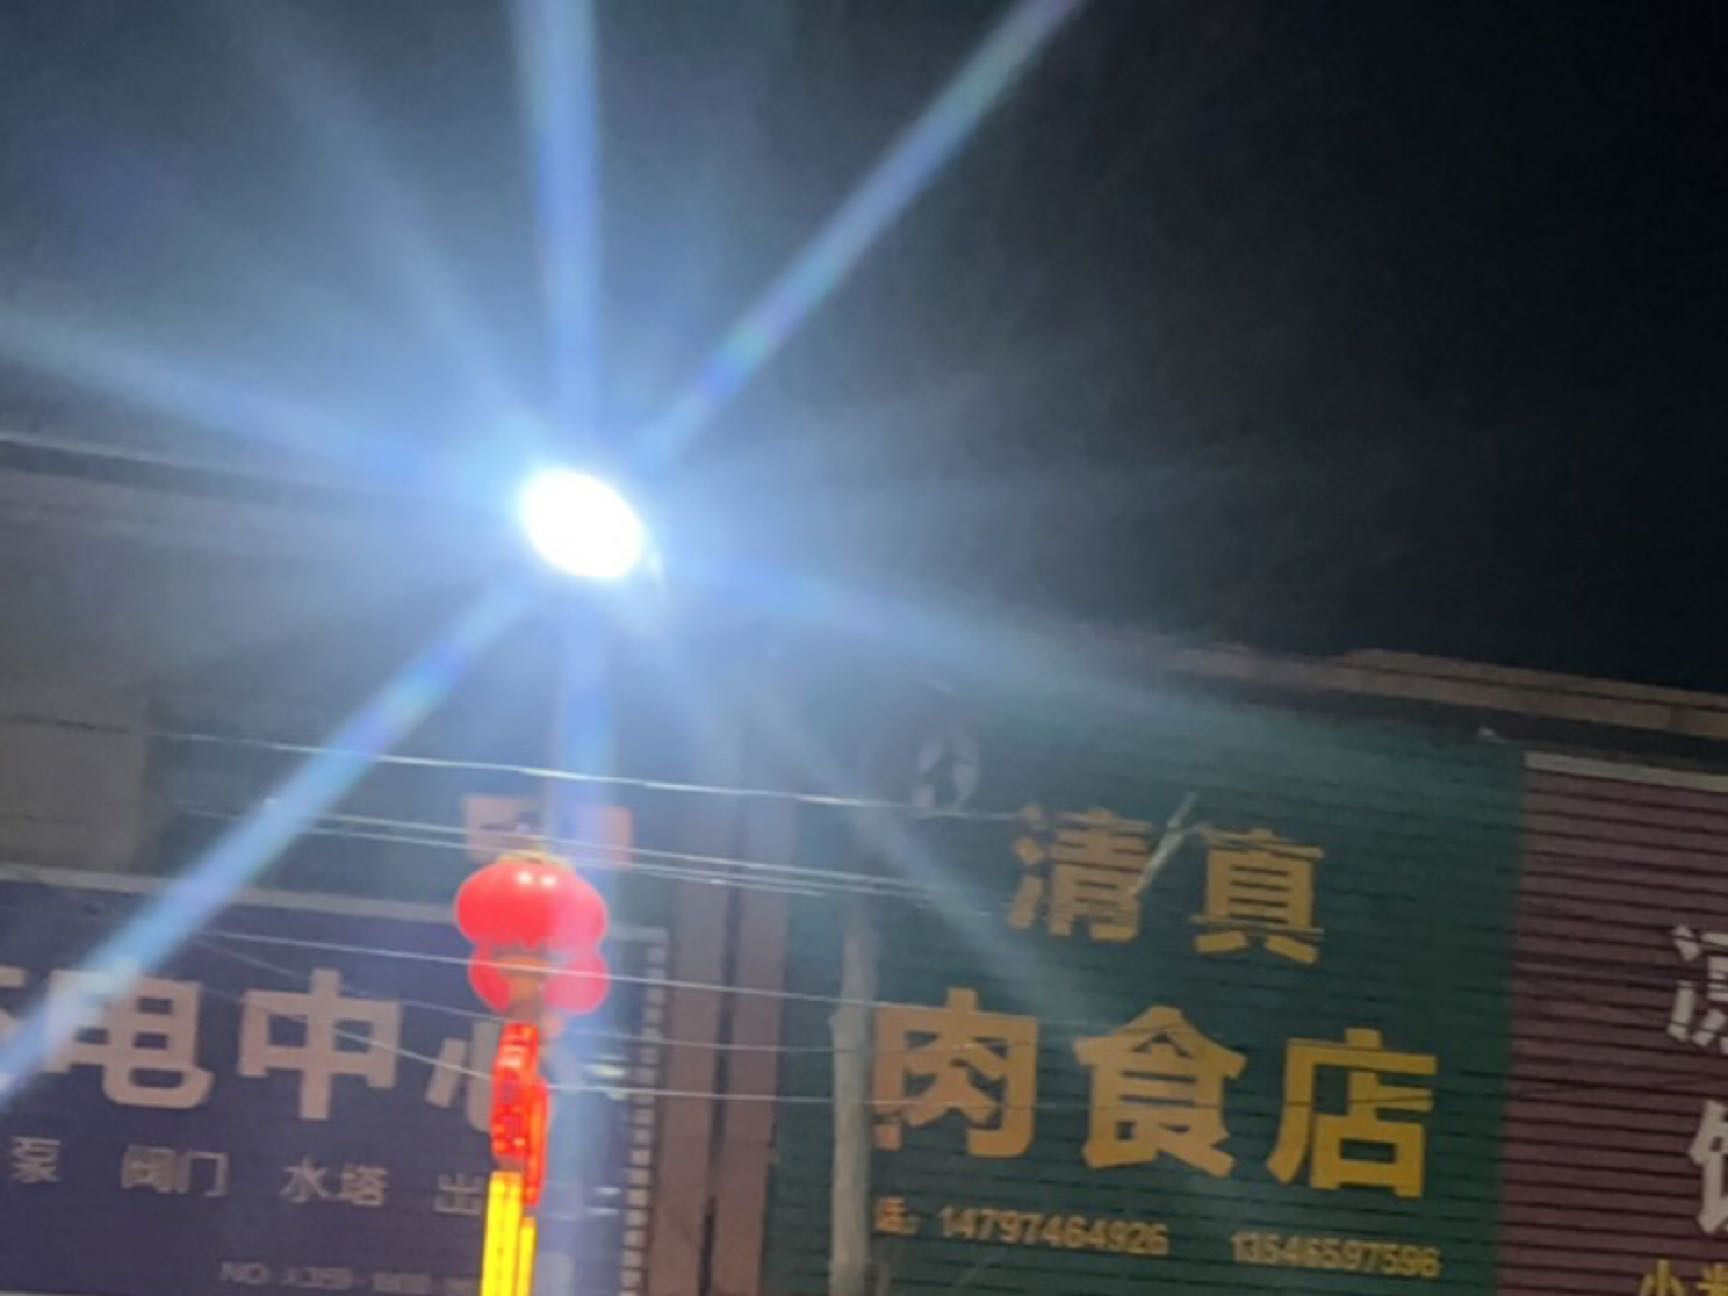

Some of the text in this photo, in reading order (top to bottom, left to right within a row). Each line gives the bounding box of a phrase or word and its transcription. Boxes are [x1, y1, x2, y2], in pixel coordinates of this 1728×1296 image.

[1008, 805, 1325, 964] 清真
[871, 986, 1438, 1198] 肉食店
[280, 1157, 389, 1209] 水塔
